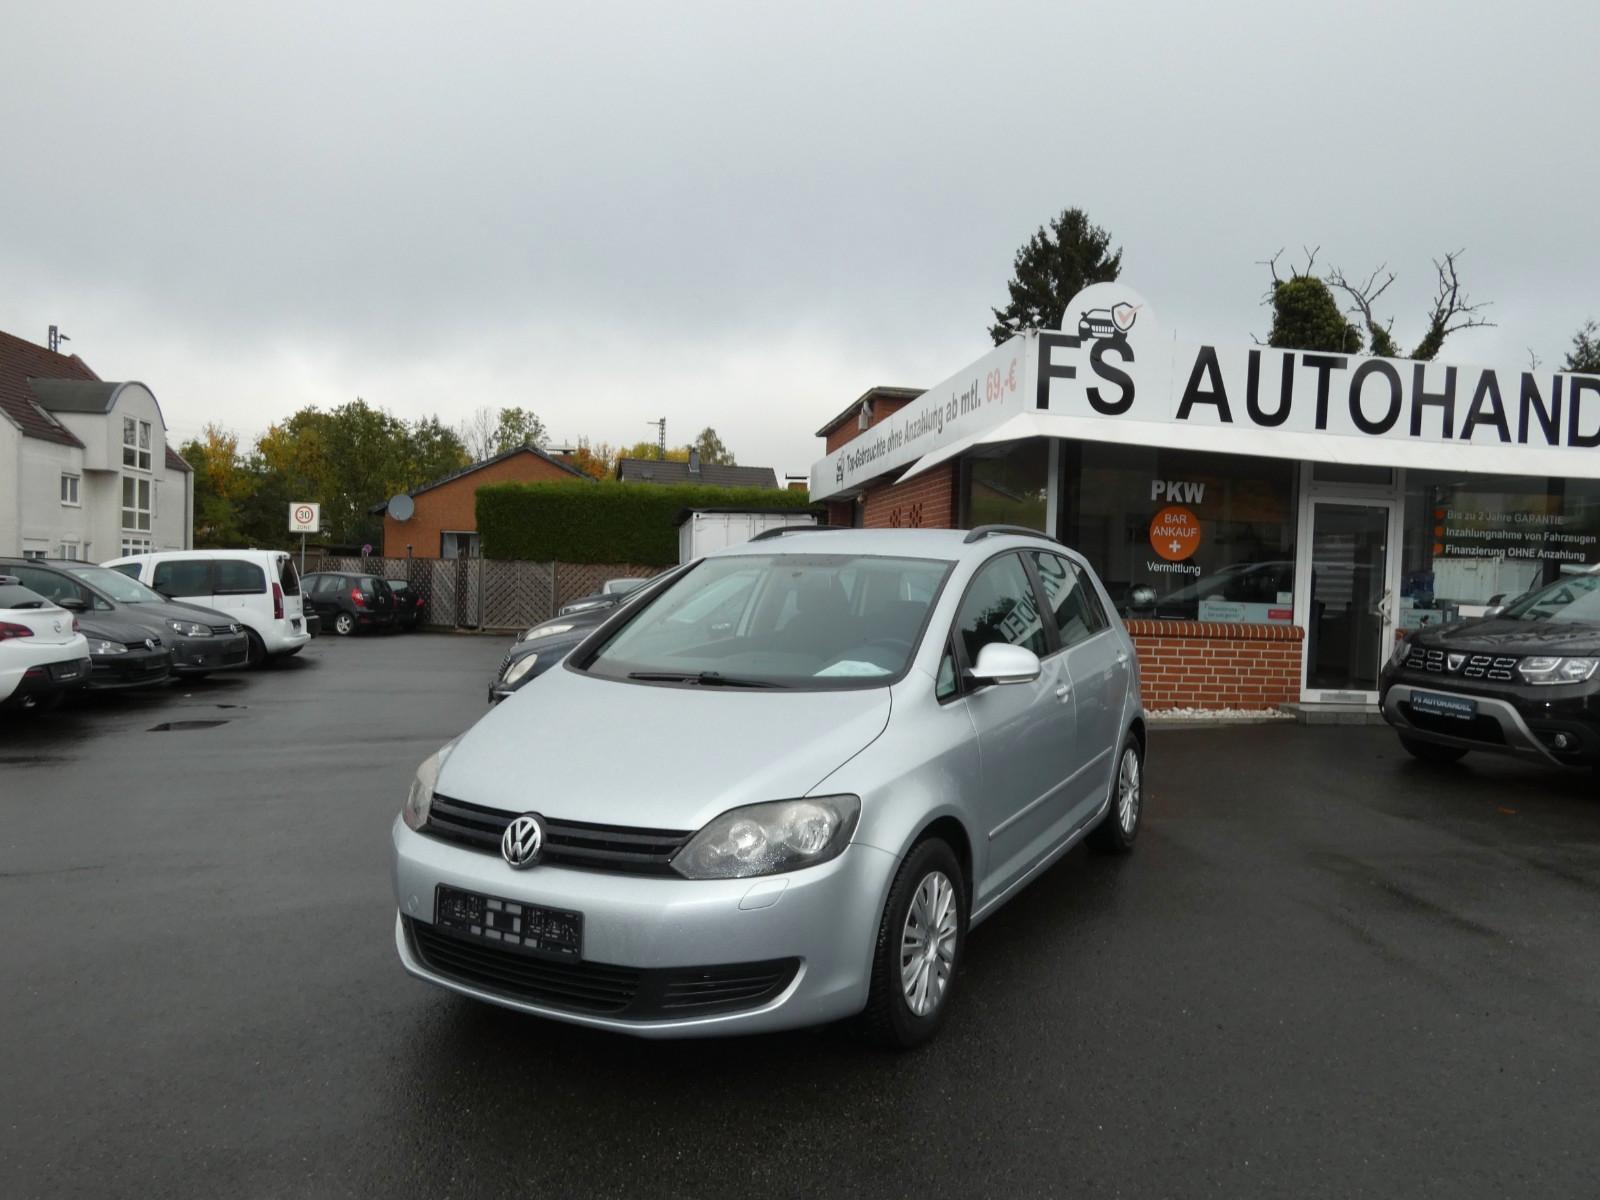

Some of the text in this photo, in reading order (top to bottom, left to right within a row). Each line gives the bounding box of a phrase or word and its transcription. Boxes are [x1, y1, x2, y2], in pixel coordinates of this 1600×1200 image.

[1036, 332, 1600, 448] FS AUTOHAND
[887, 429, 903, 454] ohne
[904, 407, 944, 445] Anzahlung
[945, 391, 958, 424] ab
[960, 379, 981, 415] mtl.
[1151, 479, 1206, 504] PKW
[299, 511, 310, 519] 30
[1164, 513, 1188, 524] BAR
[1447, 509, 1564, 526] Bis zu 2 Jahre GARANTIE
[1153, 526, 1197, 537] ANKAUF
[1446, 527, 1597, 546] Inzahlungnahme von Fahrzeugen
[1445, 544, 1586, 563] Finanzierung OHNE Anzahlung
[1146, 560, 1201, 577] Vermittlung
